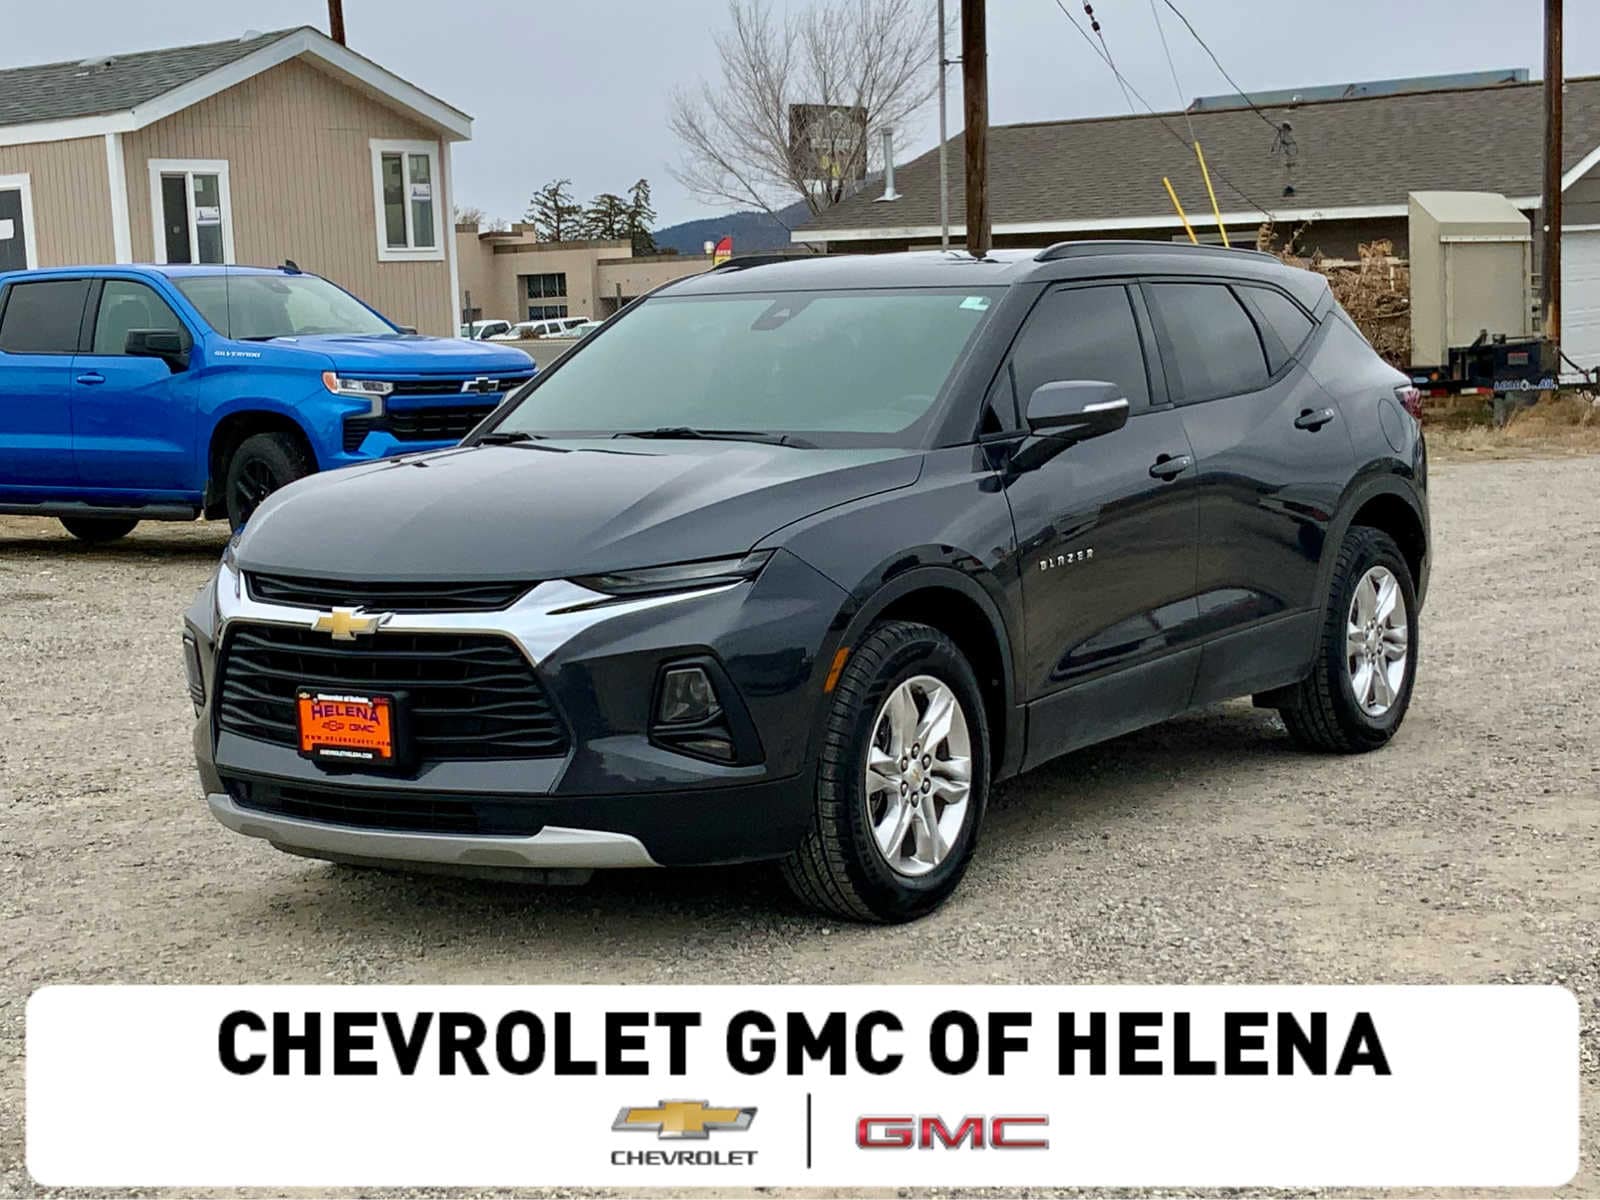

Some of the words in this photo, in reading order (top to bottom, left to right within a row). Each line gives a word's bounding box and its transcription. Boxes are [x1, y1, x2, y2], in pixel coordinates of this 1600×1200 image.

[1039, 548, 1094, 571] BLAZER
[311, 704, 380, 725] HELENA
[349, 723, 376, 733] GMC
